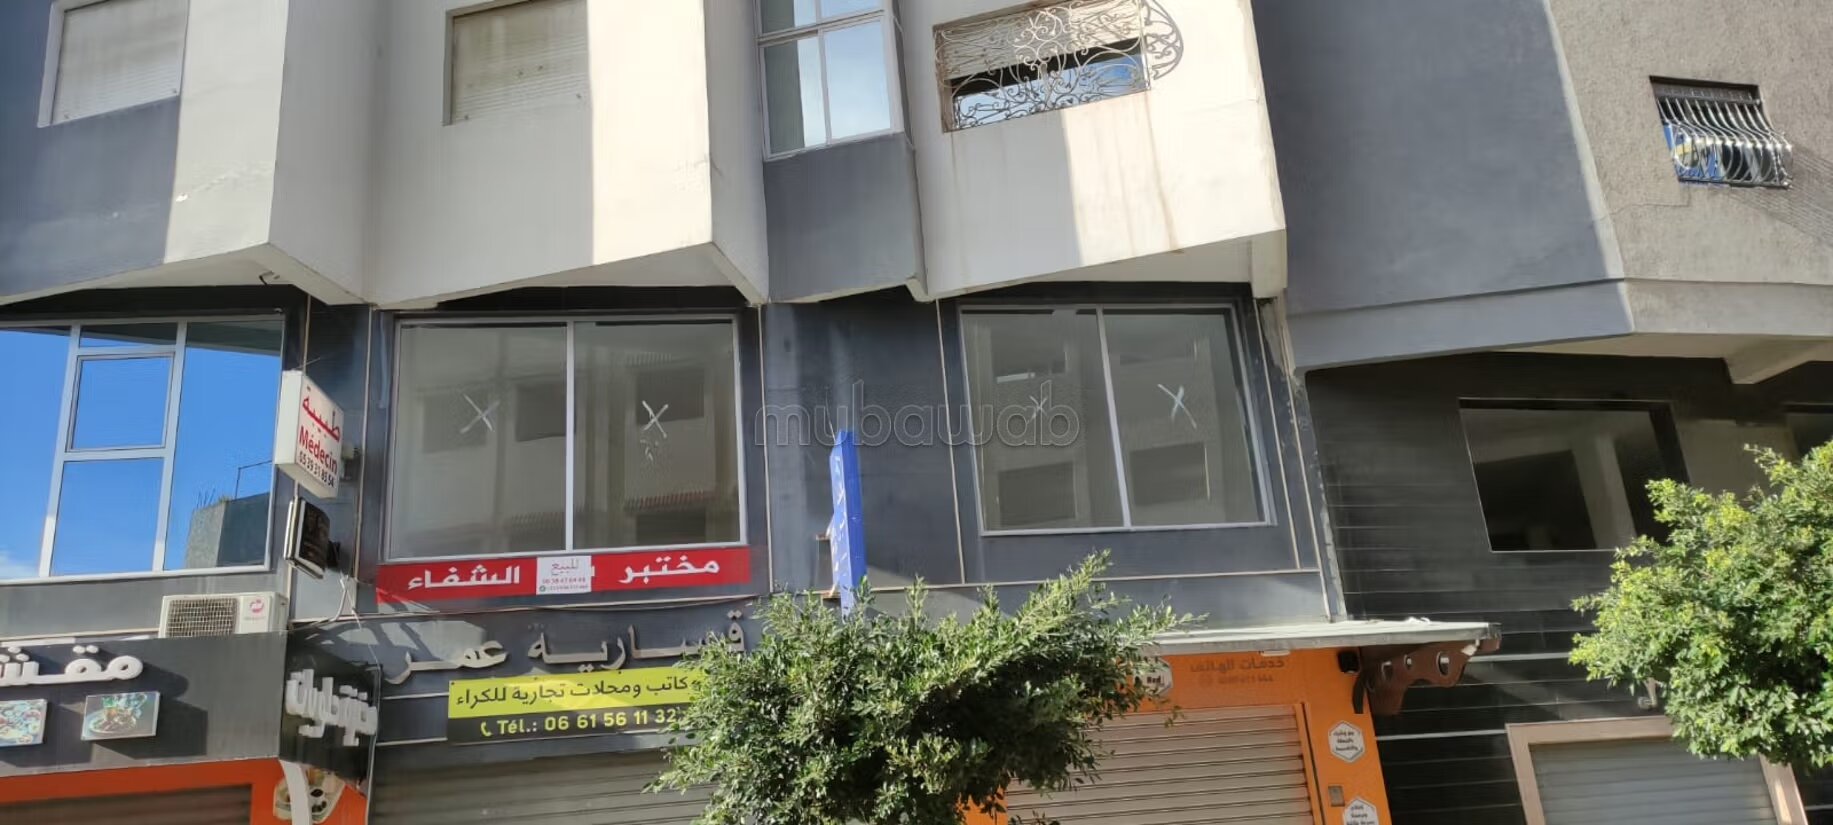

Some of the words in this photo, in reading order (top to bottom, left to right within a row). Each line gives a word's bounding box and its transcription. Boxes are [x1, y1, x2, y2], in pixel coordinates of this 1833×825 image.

[302, 386, 340, 442] طبيبة
[299, 426, 338, 475] Médecin
[408, 564, 520, 590] الشفاء
[618, 555, 720, 584] مختبر
[384, 640, 509, 685] عمر
[456, 687, 507, 709] للكراء
[511, 682, 566, 704] تجارية
[570, 680, 642, 698] ومحلات
[544, 715, 569, 731] 06
[576, 713, 597, 729] 61
[603, 711, 627, 727] 56
[633, 709, 648, 725] 11
[654, 708, 677, 724] 32
